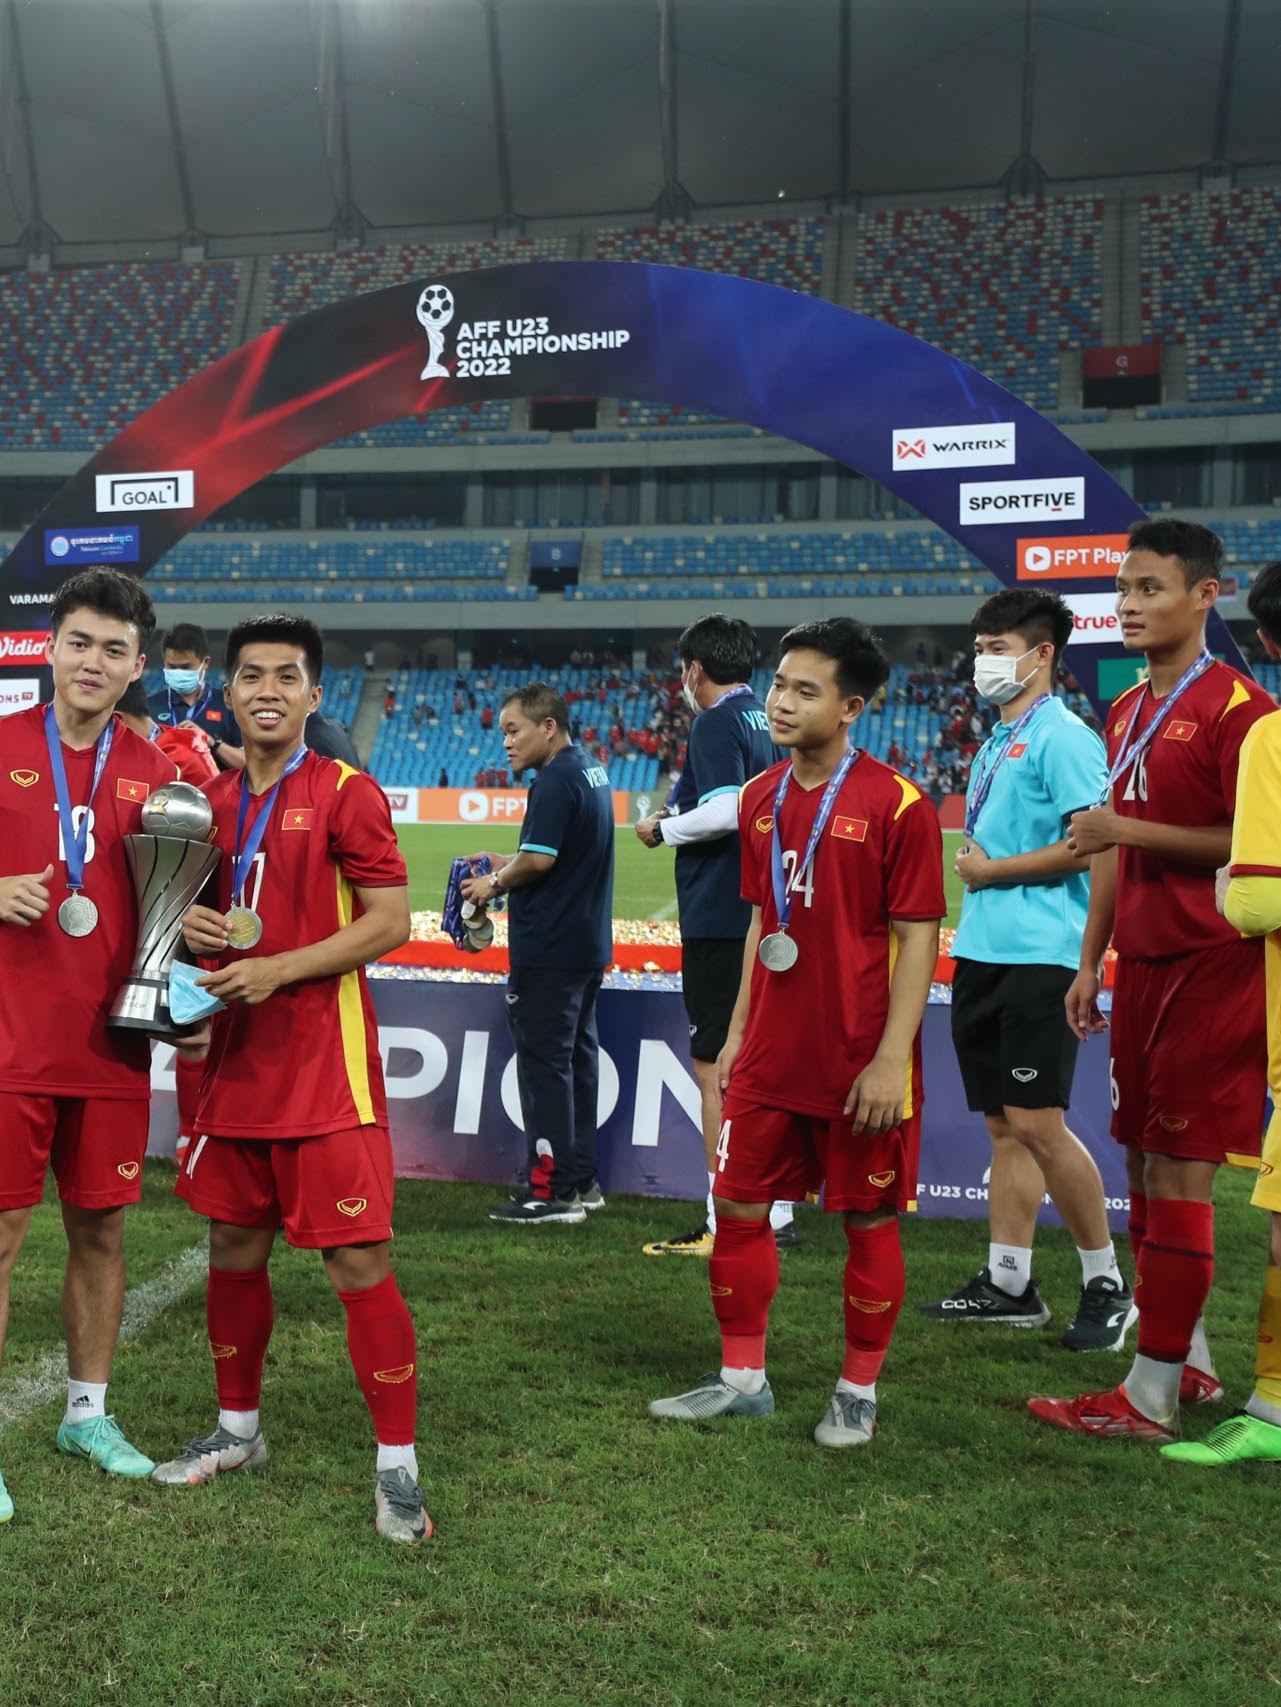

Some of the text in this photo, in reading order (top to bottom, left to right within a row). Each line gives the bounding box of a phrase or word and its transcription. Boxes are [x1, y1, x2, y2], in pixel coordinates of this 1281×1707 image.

[456, 317, 549, 340] AFF U23
[456, 330, 630, 359] CHAMPIONSHIP
[456, 358, 511, 378] 2022
[932, 439, 1007, 452] WARRIX
[122, 491, 167, 505] GOAL
[969, 492, 1076, 511] SPORTFIVE
[1053, 548, 1090, 566] FPT
[53, 803, 96, 864] 18
[781, 849, 815, 908] 24
[929, 1184, 962, 1199] U23
